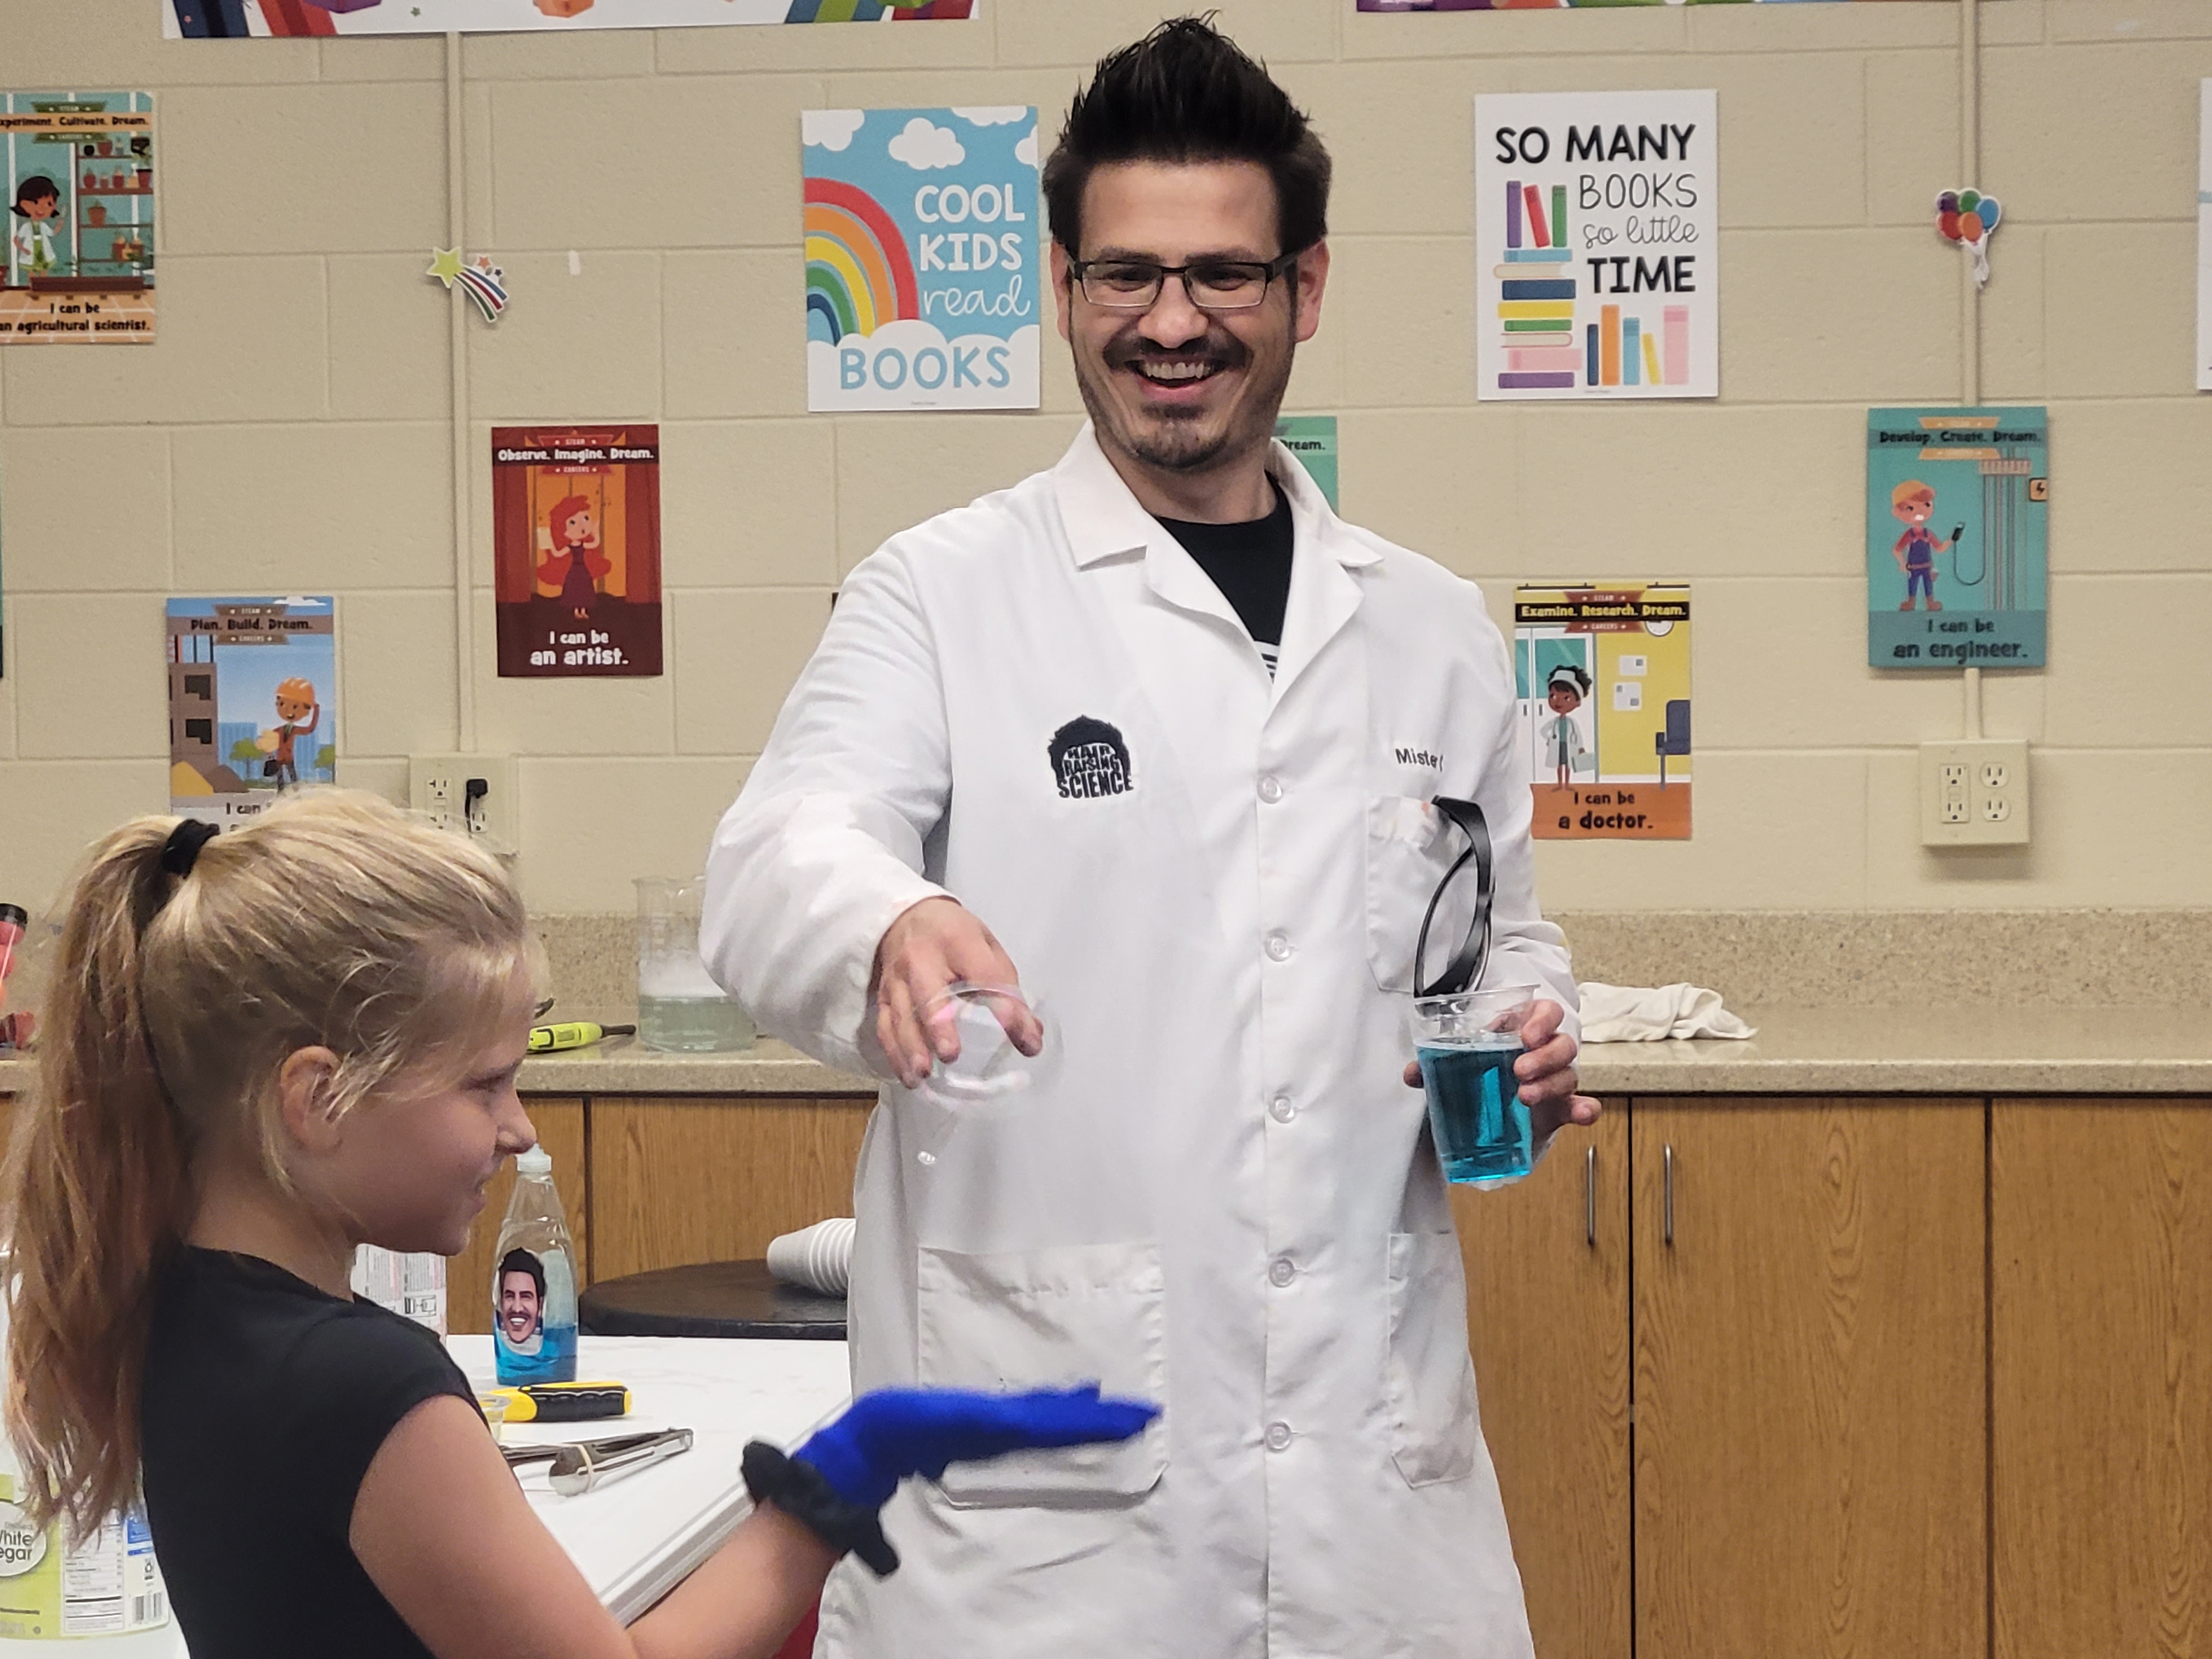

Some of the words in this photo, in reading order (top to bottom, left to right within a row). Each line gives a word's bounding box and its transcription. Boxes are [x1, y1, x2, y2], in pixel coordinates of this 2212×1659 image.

[0, 117, 55, 129] xperiment.
[59, 116, 109, 126] Cultivate.
[112, 116, 149, 125] Dream.
[1496, 126, 1550, 164] SO
[1565, 123, 1696, 162] MANY
[1579, 172, 1697, 210] BOOKS
[915, 183, 1025, 223] COOL
[1583, 224, 1618, 249] so
[1626, 215, 1699, 244] little
[920, 233, 1023, 271] KIDS
[1587, 255, 1696, 294] TIME
[924, 274, 1030, 317] read
[50, 303, 54, 314] I
[59, 304, 81, 313] can
[85, 302, 100, 313] be
[0, 322, 12, 331] an
[17, 319, 89, 335] agricultural
[94, 319, 150, 330] scientist.
[840, 346, 1010, 390] BOOKS
[1880, 431, 1934, 445] Develop.
[1940, 431, 1987, 442] Create.
[1993, 431, 2040, 442] Dream.
[498, 449, 551, 461] Observe.
[554, 448, 606, 464] Imagine.
[610, 448, 654, 459] Dream.
[1521, 606, 1578, 617] Examine.
[1582, 603, 1639, 617] Research.
[1643, 605, 1686, 616] Dream.
[191, 619, 222, 630] Plan.
[228, 618, 263, 630] Build.
[269, 618, 313, 630] Dream.
[1928, 618, 1933, 633] I
[1940, 620, 1968, 633] can
[1976, 618, 1995, 633] be
[550, 631, 555, 645] I
[560, 633, 586, 645] can
[591, 629, 610, 645] be
[530, 651, 556, 666] an
[563, 646, 629, 665] artist.
[1893, 644, 1920, 658] an
[1929, 641, 2028, 665] engineer.
[1064, 754, 1120, 777] RAISING
[1057, 770, 1134, 799] SCIENCE
[1575, 792, 1579, 805] I
[1585, 794, 1611, 804] can
[1618, 791, 1635, 805] be
[227, 802, 230, 815] I
[236, 804, 261, 814] can
[1558, 815, 1570, 830] a
[1579, 810, 1654, 830] doctor.
